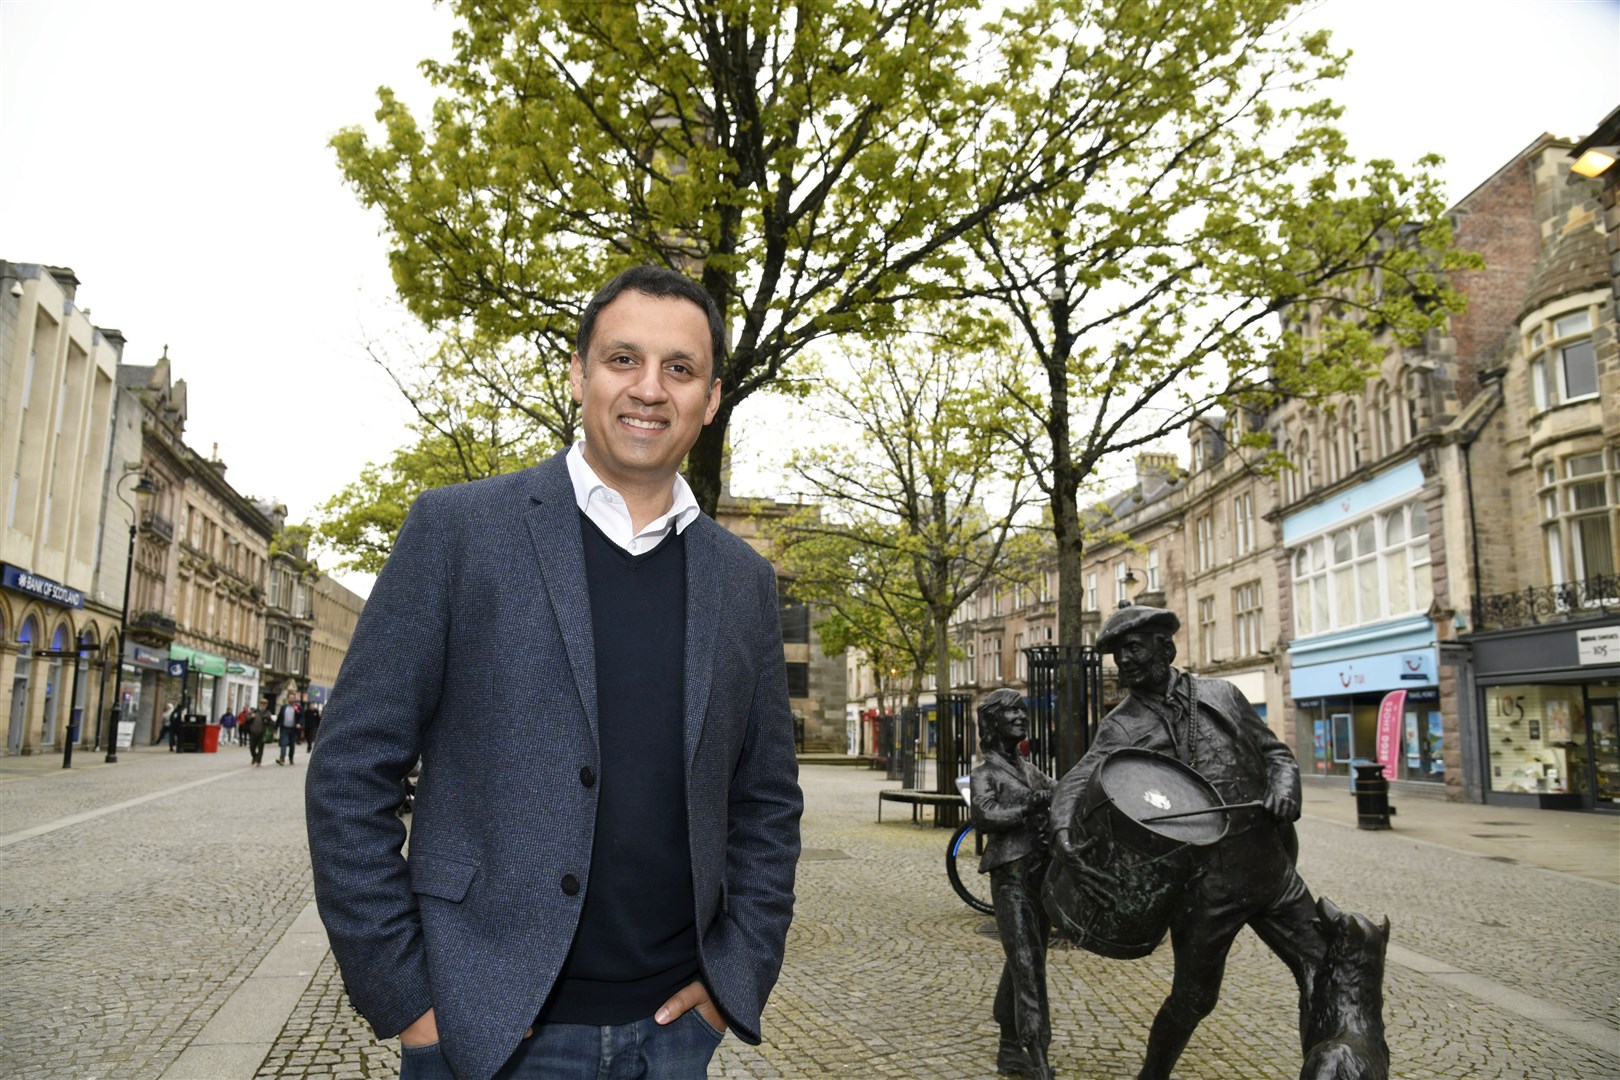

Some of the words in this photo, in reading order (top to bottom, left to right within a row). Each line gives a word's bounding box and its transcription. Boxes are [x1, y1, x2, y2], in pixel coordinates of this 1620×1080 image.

[26, 575, 44, 594] BANK
[43, 582, 53, 596] OF
[52, 585, 80, 606] SCOTLAND
[1593, 645, 1608, 657] 105
[1382, 701, 1393, 733] SHOES
[1495, 696, 1525, 720] 105
[1380, 735, 1390, 761] BEGG
